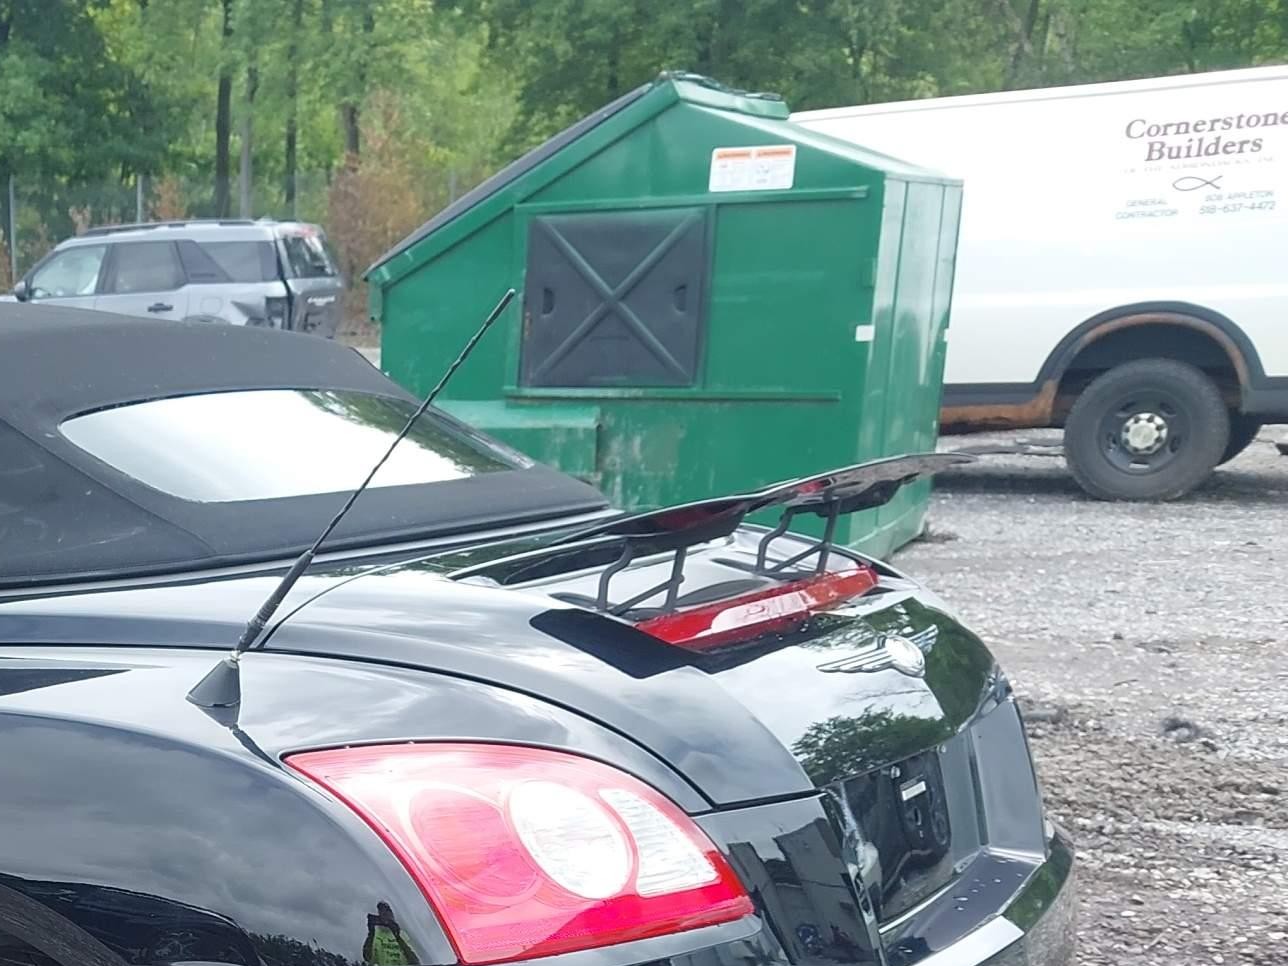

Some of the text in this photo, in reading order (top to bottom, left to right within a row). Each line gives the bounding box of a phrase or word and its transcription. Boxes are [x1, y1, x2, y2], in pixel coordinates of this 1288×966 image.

[1125, 111, 1288, 139] Cornerstone
[1144, 136, 1263, 162] Builders
[1126, 198, 1168, 207] GENERAL
[1115, 208, 1179, 220] CONTRACTOR
